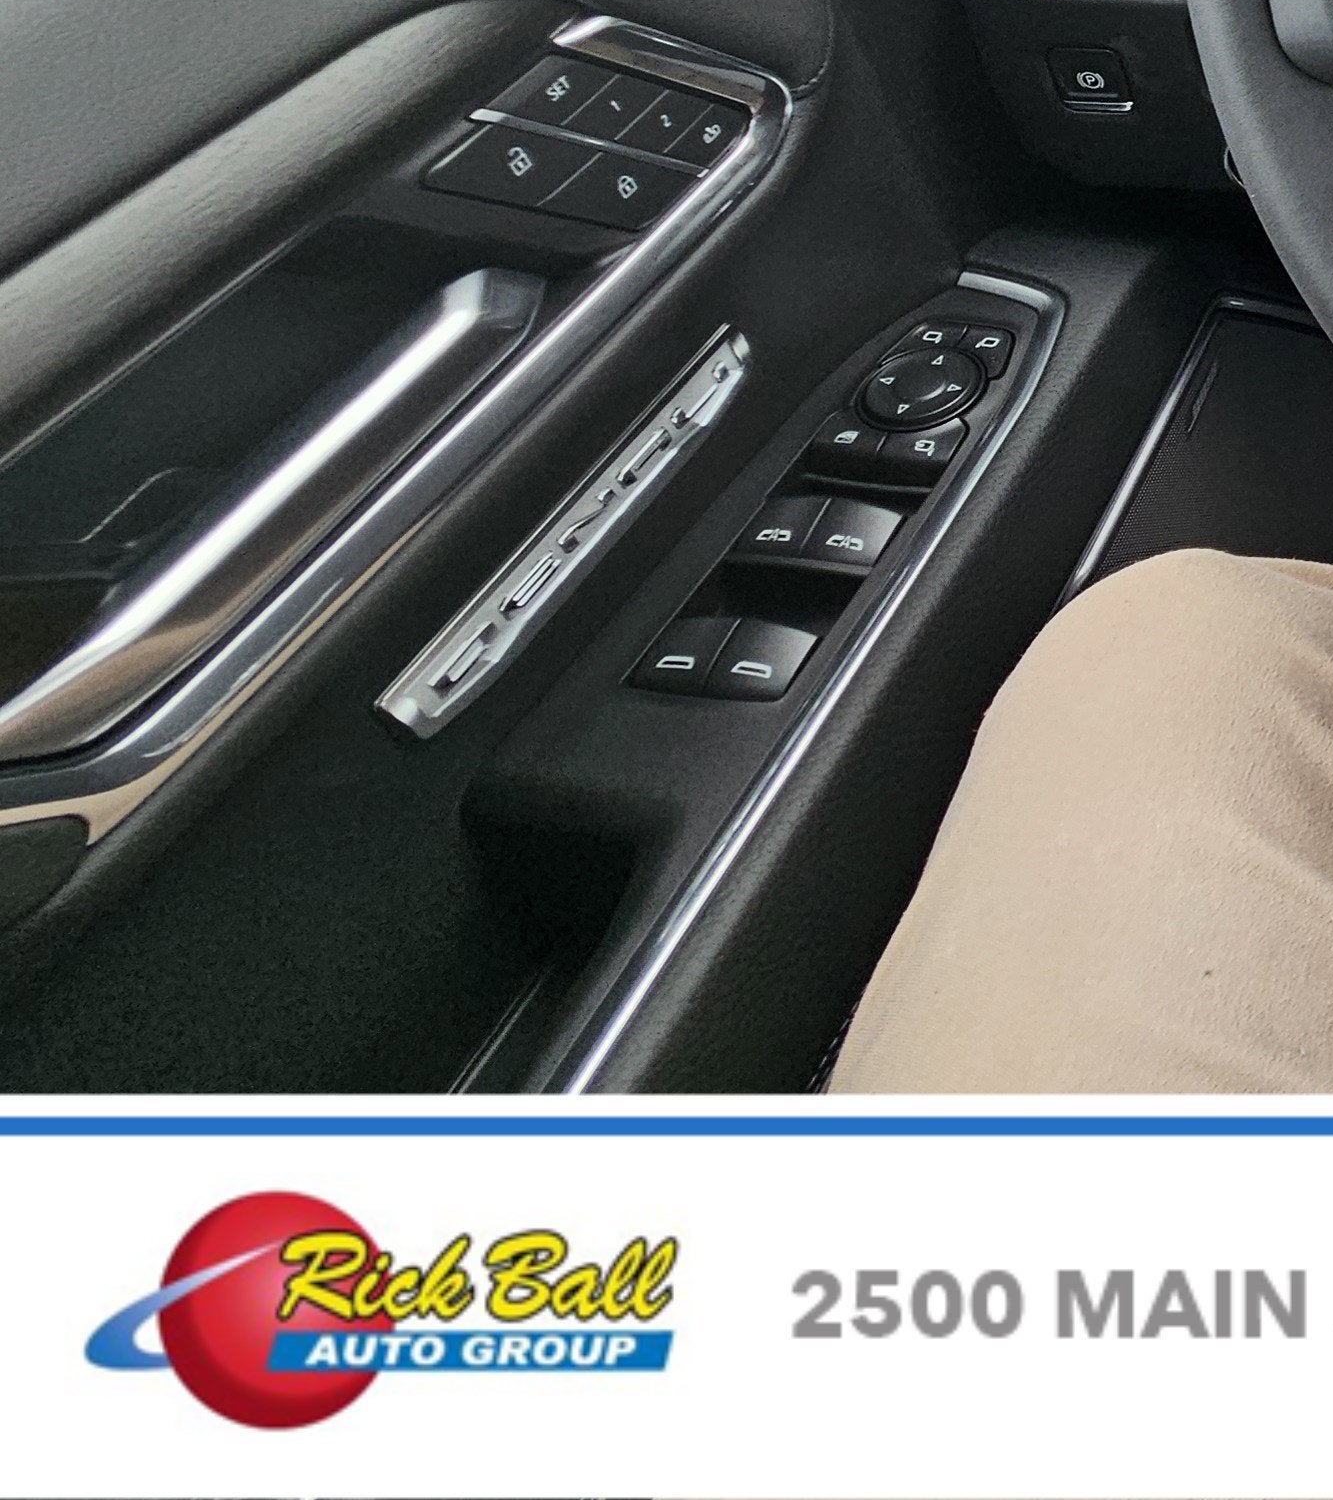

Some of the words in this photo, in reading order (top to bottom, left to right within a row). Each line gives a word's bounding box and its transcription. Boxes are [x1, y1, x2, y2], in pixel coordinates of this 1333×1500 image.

[545, 75, 571, 102] SET
[610, 100, 622, 112] 1
[660, 114, 672, 128] 2
